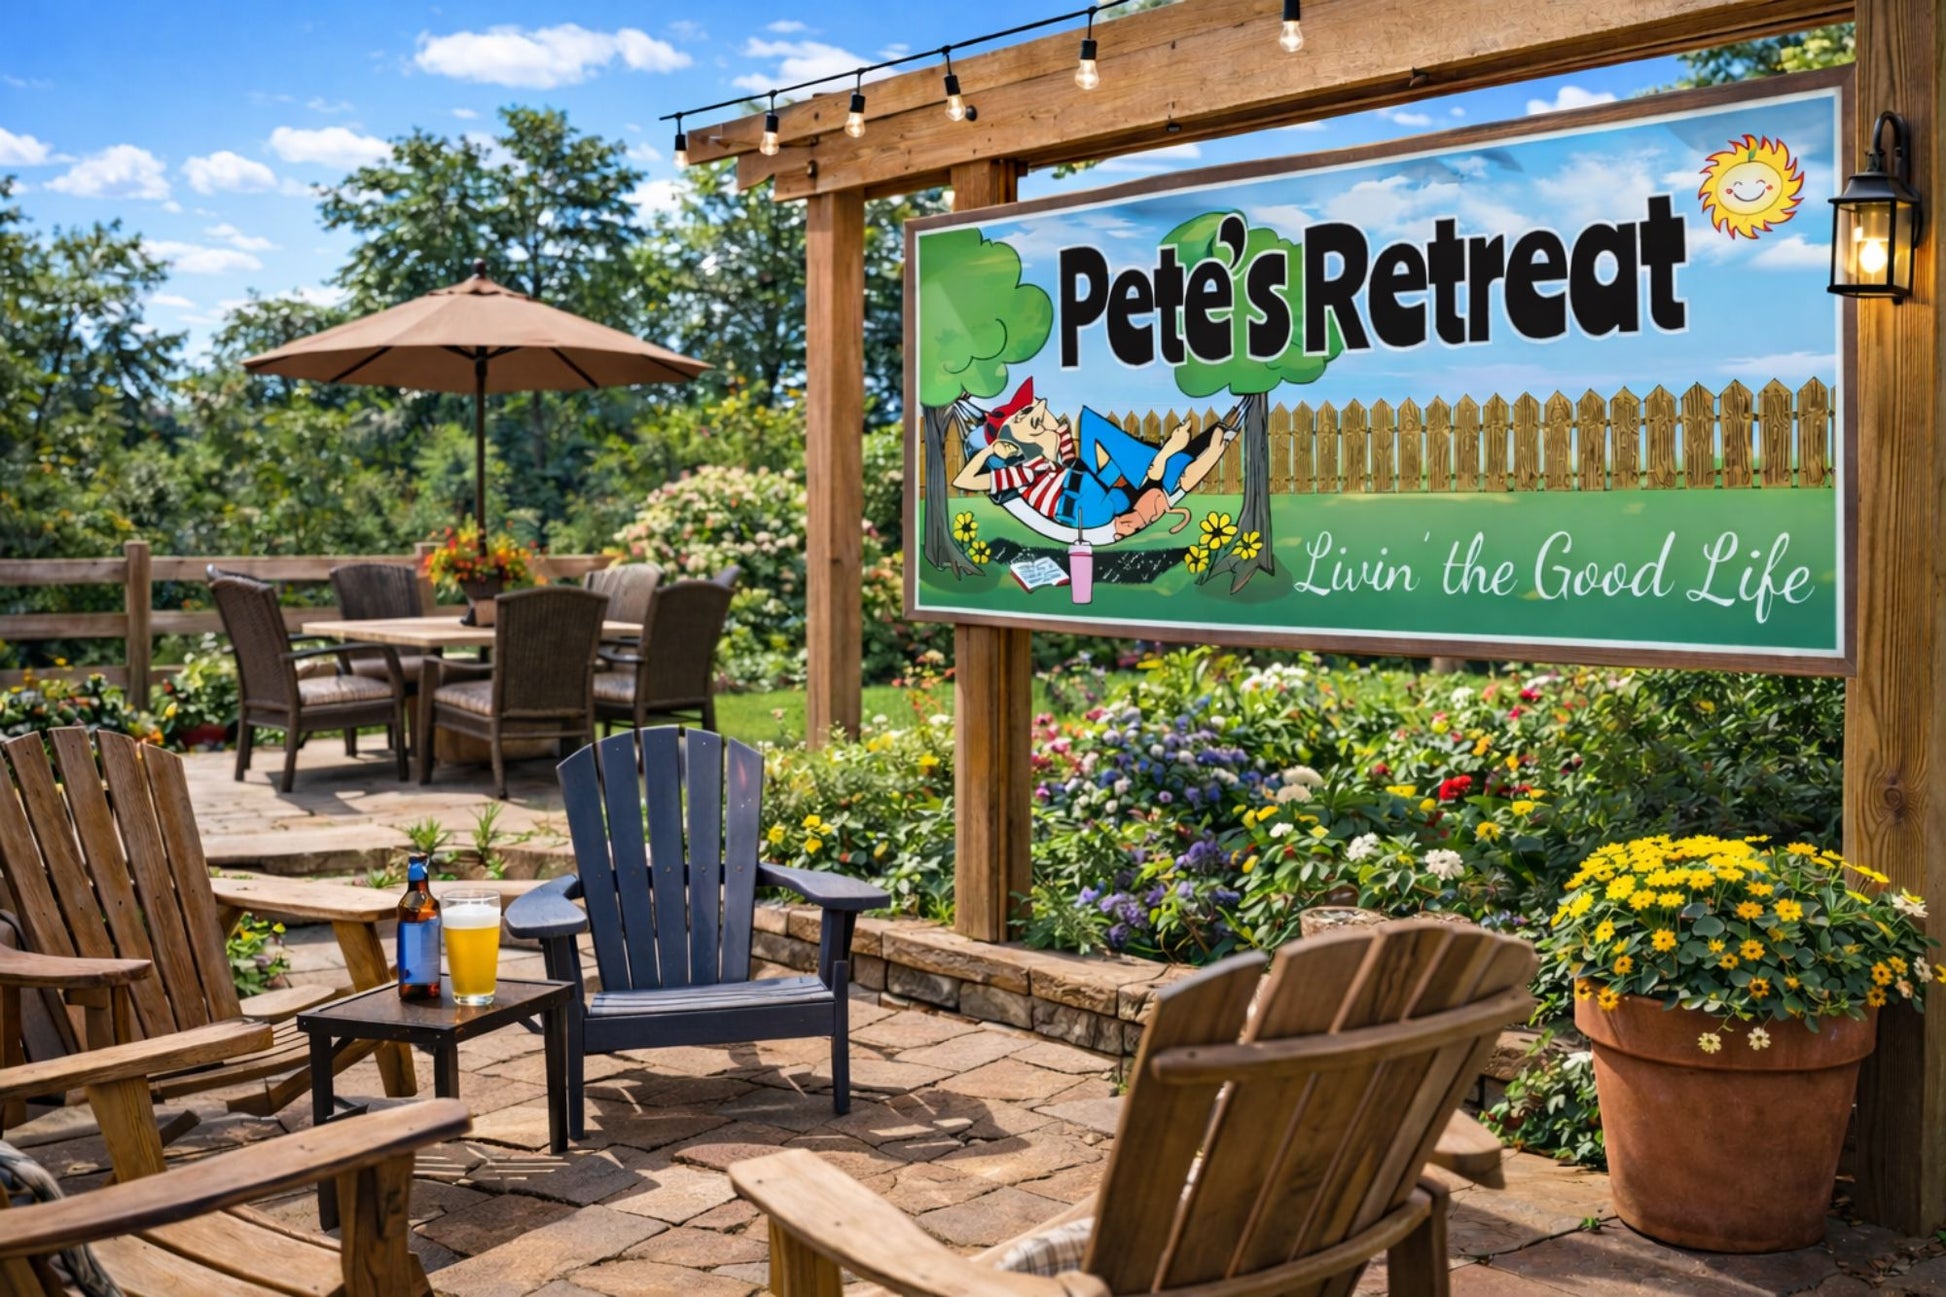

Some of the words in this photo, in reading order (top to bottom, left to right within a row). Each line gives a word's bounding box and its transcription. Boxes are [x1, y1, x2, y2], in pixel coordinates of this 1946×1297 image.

[1059, 215, 1292, 368] Pete's
[1303, 194, 1687, 355] Retreat
[1294, 531, 1430, 596] Livin'
[1443, 531, 1518, 596] the
[1534, 531, 1675, 600] Good
[1686, 531, 1815, 624] Life
